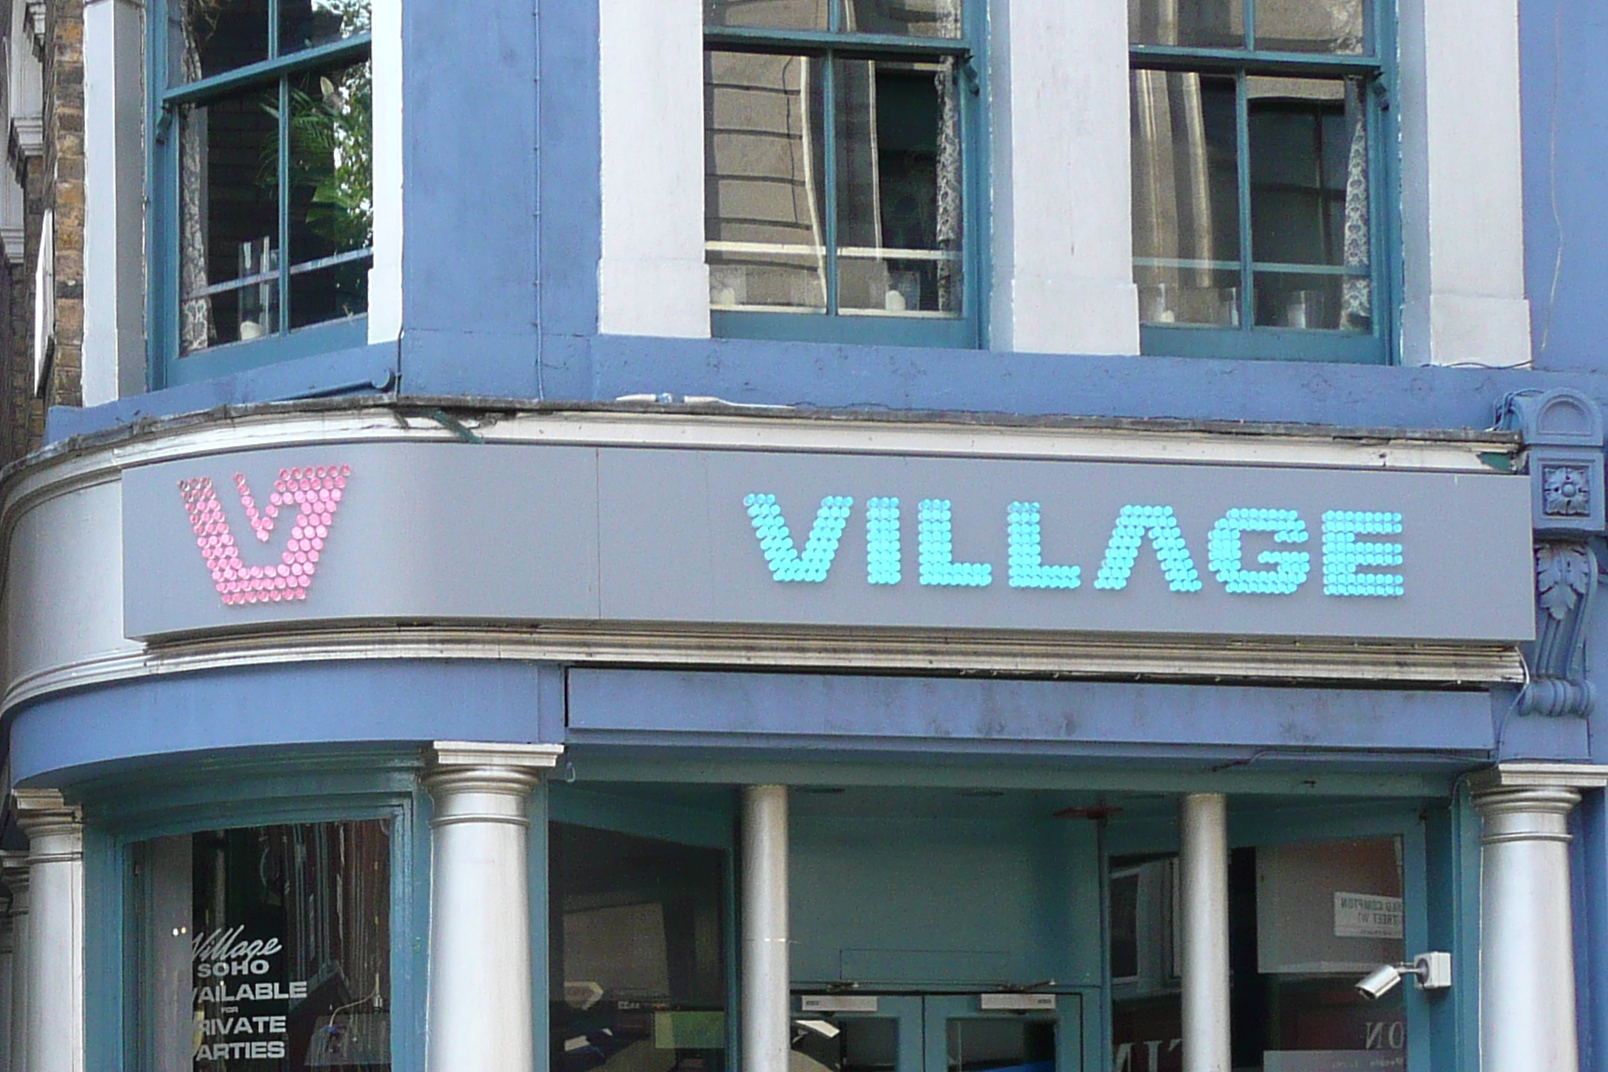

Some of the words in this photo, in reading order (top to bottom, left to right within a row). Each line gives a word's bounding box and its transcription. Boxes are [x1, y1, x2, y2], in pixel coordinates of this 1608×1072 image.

[743, 492, 1403, 597] VILLAGE
[197, 959, 270, 979] SOHO
[221, 1006, 239, 1014] FOR
[195, 1041, 285, 1062] ARTIES
